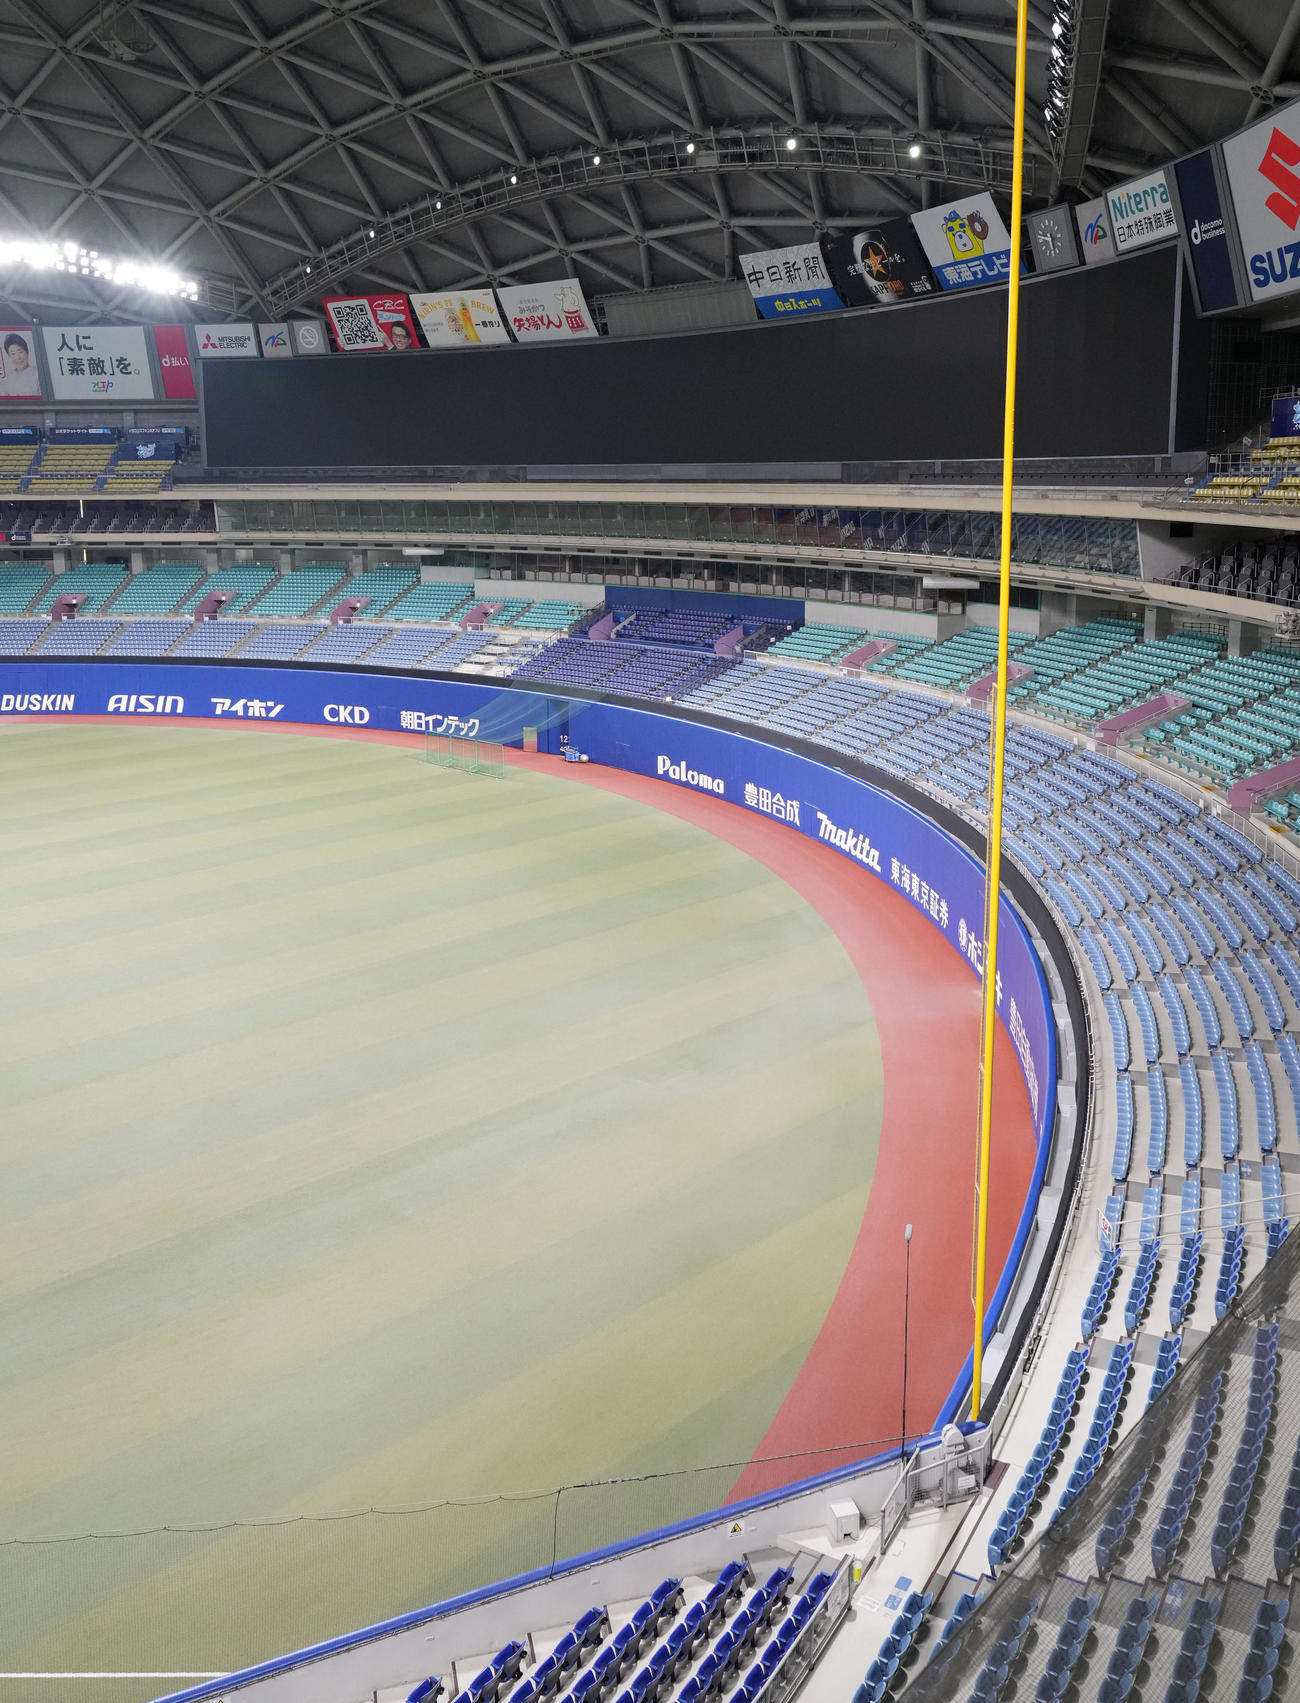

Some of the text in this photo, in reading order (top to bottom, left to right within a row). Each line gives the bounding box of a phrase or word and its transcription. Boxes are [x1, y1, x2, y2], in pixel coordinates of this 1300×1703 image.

[1111, 183, 1170, 222] Niterra
[1117, 208, 1175, 243] 日本特殊陶業
[1200, 219, 1223, 230] docomo
[1201, 227, 1225, 240] business
[746, 256, 826, 289] 中日新聞
[942, 254, 1011, 285] 東海テレビ
[373, 299, 405, 310] CBC
[774, 298, 822, 312] 中日スポーツ
[513, 313, 563, 332] 矢場とん
[57, 333, 94, 352] 人に
[58, 356, 141, 376] 「素敵」を。
[162, 354, 189, 367] d払い
[107, 694, 184, 713] AISIN
[211, 697, 285, 718] アイホン
[323, 703, 370, 725] CKD
[400, 710, 479, 737] 朝日インテック
[657, 755, 725, 794] Paloma
[743, 781, 801, 826] 豊田合成
[890, 856, 949, 929] 東海東京証券
